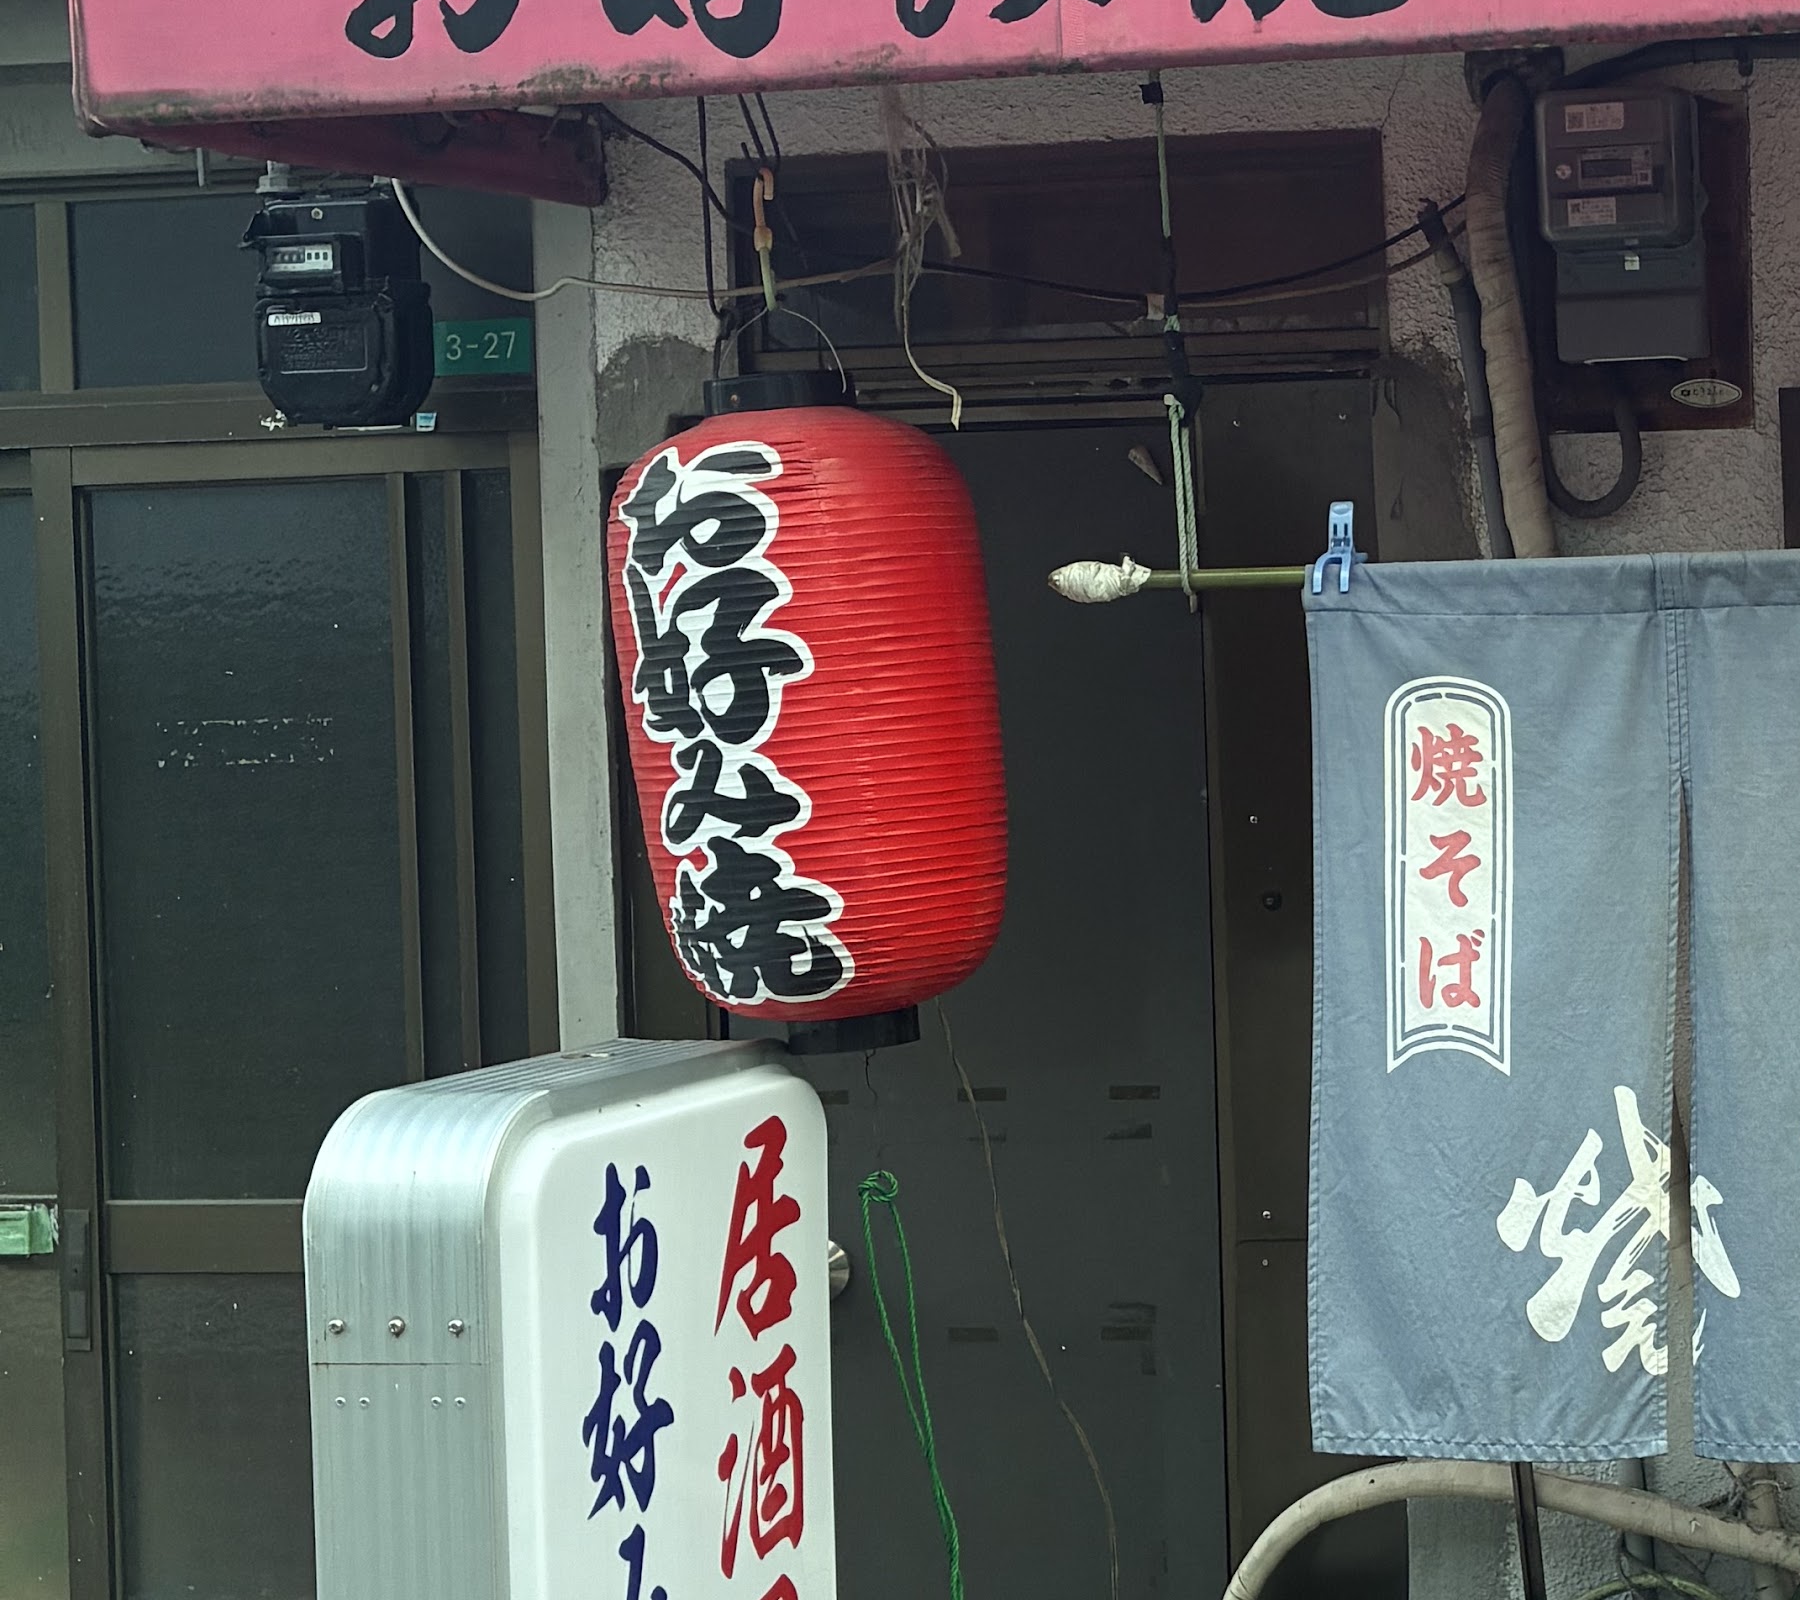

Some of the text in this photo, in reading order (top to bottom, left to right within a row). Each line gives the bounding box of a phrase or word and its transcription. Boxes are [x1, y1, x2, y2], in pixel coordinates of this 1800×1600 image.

[446, 331, 516, 361] 3-27
[620, 440, 856, 1004] お好み焼
[1410, 723, 1487, 1013] 焼そば
